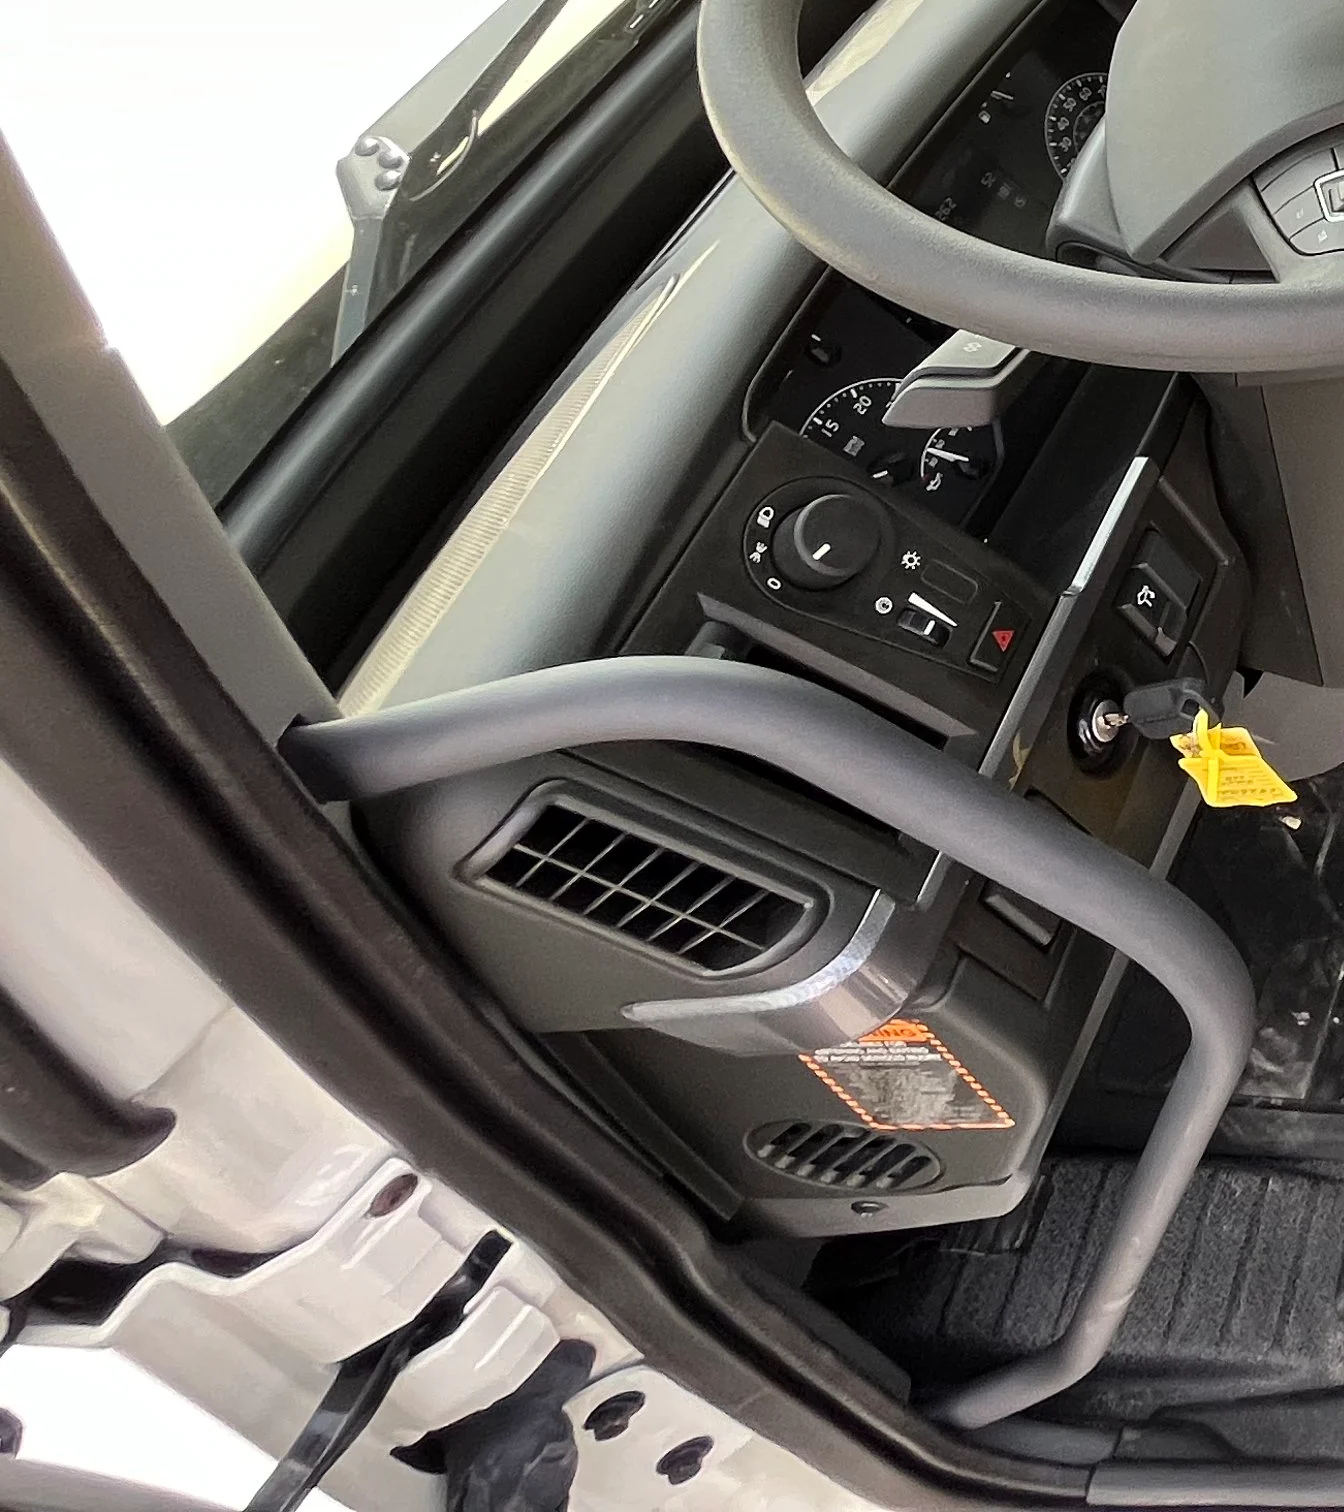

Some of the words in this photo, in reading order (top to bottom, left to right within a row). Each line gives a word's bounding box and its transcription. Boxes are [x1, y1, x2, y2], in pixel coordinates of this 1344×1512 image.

[1079, 87, 1092, 101] 60
[1063, 97, 1077, 112] 50
[1057, 117, 1070, 131] 40
[1059, 136, 1072, 152] 30
[853, 395, 872, 415] 20
[821, 418, 840, 438] 15
